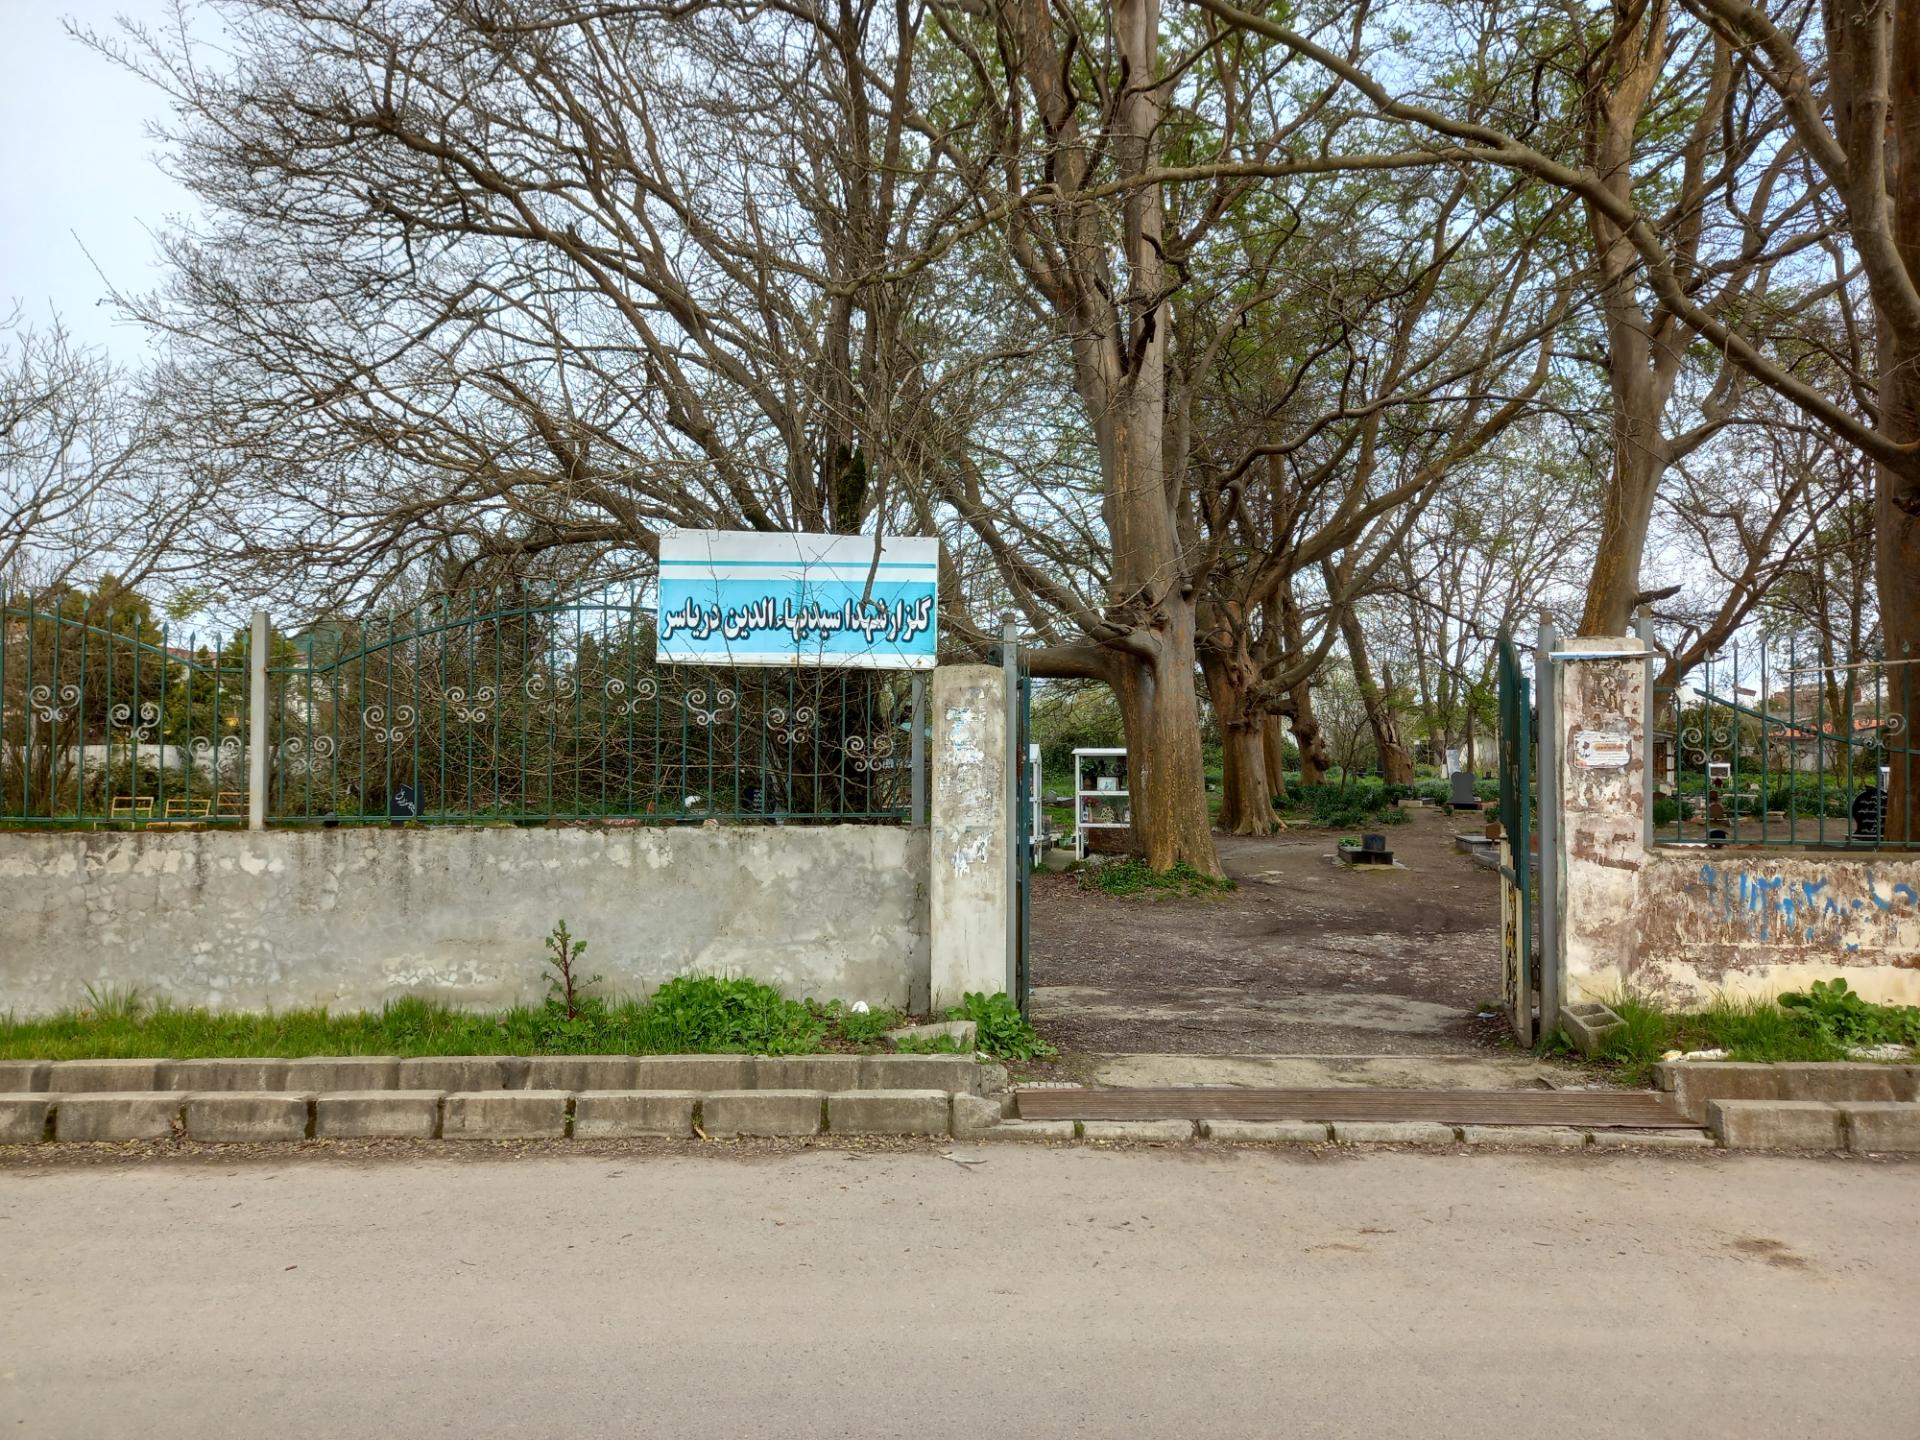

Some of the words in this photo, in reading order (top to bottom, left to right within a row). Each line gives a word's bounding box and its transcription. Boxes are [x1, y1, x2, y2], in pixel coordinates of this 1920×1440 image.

[661, 596, 722, 640] دریاسر
[844, 597, 889, 643] شهدا
[886, 595, 933, 642] گلزار
